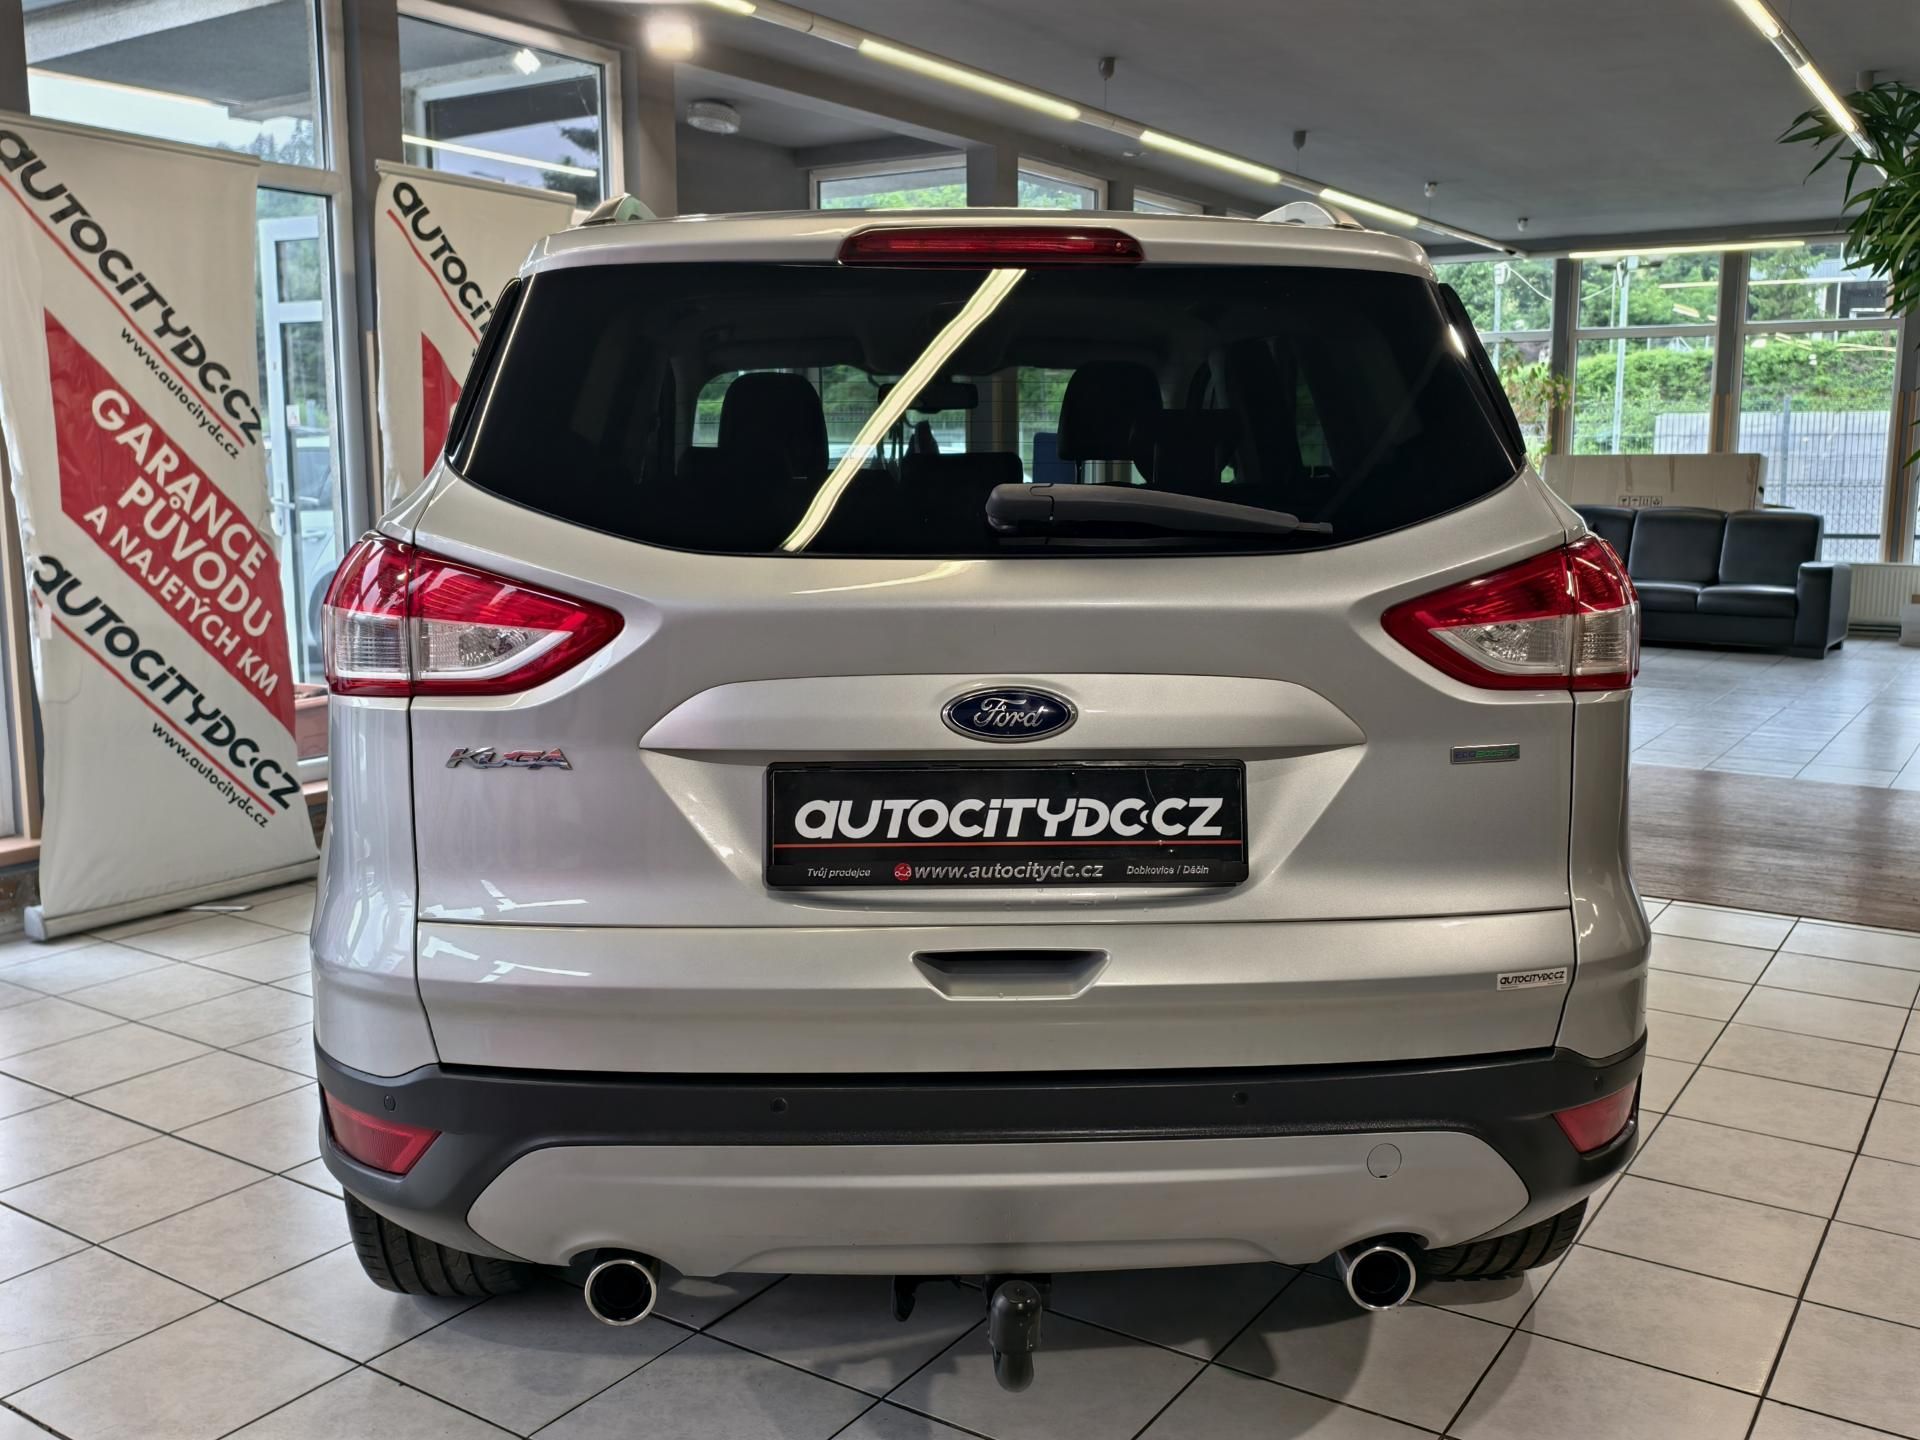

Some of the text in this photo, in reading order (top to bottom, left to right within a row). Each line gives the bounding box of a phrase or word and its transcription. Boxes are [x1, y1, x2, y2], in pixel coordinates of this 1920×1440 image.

[121, 327, 239, 459] www.autocitydc.cz
[91, 388, 268, 579] GARANCE
[83, 505, 279, 697] A NAJETÝCH KM
[117, 475, 273, 637] PŮVODU
[973, 697, 1049, 728] Ford
[152, 721, 269, 828] www.autocitydc.cz
[807, 866, 871, 878] Tvůj prodejce
[914, 861, 1104, 882] www.autocitydc.cz
[1126, 865, 1175, 875] Dobkovice
